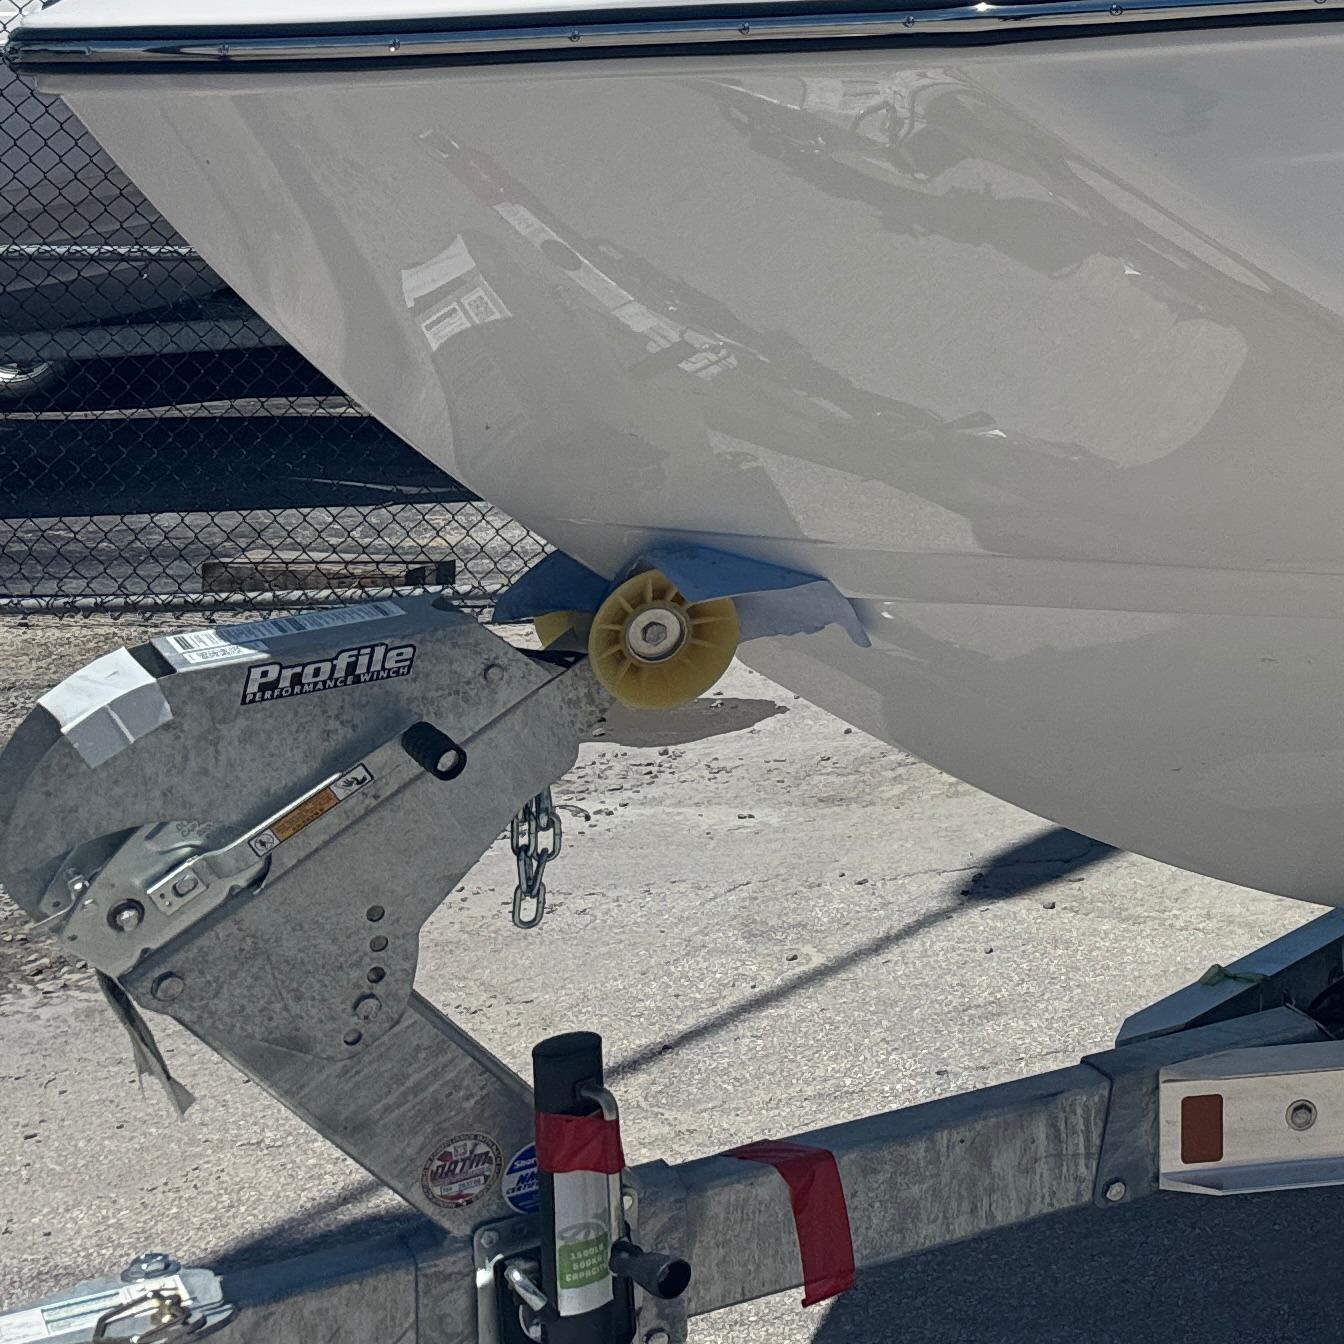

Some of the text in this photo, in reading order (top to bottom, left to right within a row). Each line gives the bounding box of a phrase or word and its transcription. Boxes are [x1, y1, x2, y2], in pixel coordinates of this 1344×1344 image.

[246, 644, 414, 694] Profile
[246, 666, 408, 703] PERFORMANCE WINCH
